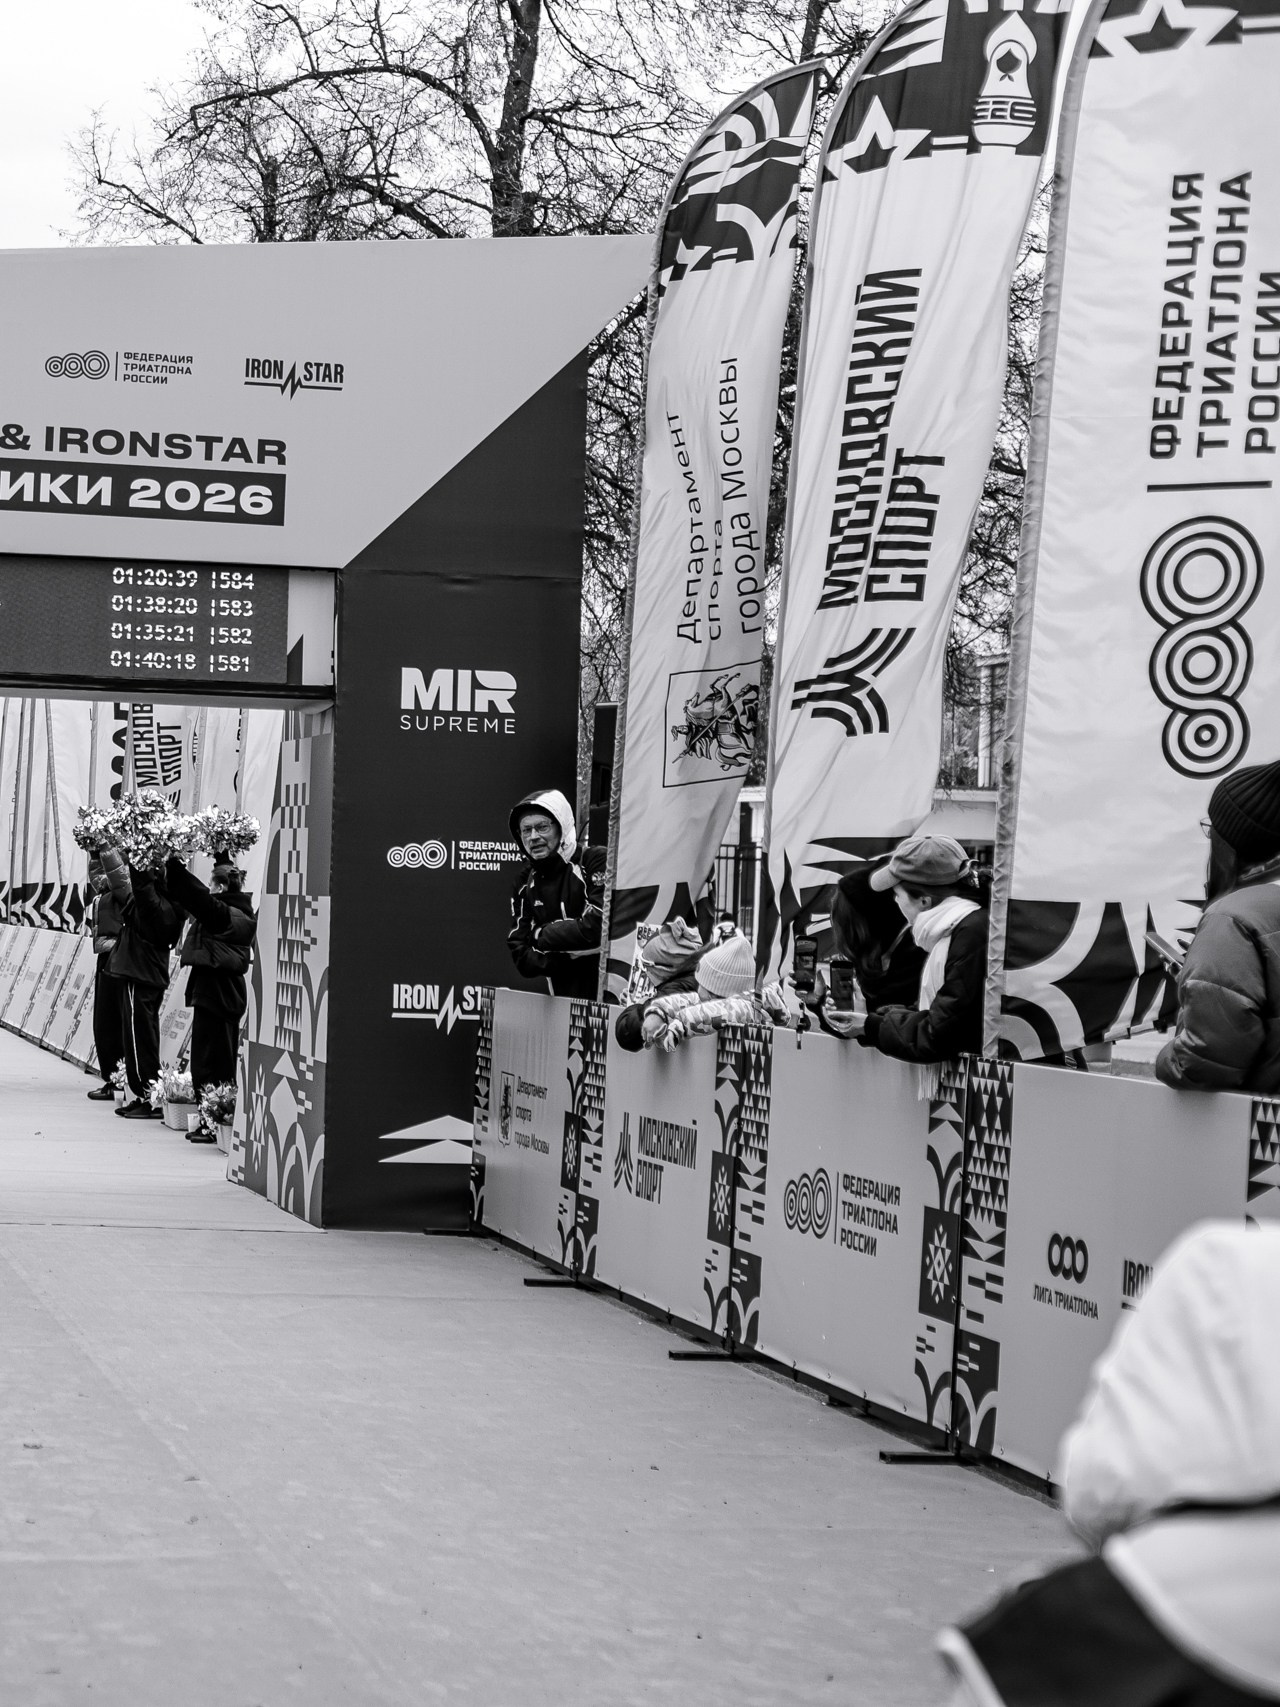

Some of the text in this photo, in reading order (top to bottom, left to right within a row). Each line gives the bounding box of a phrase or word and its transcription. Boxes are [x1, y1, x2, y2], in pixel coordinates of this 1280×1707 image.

[1149, 172, 1205, 459] ФЕДЕРАЦИЯ
[1196, 170, 1253, 458] ТРИАТЛОНА
[123, 352, 193, 364] ФЕДЕРАЦИЯ
[123, 363, 192, 375] ТРИАТЛОНА
[245, 358, 344, 383] IRON STAR
[1245, 272, 1280, 454] РОССИИ
[123, 374, 168, 384] РОССИИ
[45, 426, 287, 466] IRONSTAR
[815, 268, 923, 612] МОСКОВСКИЙ
[129, 478, 273, 515] 2026
[718, 358, 762, 634] города Москвы
[666, 411, 709, 643] Департамент
[863, 448, 945, 602] СПОРТ
[707, 520, 724, 641] спорта
[401, 667, 517, 713] MIR
[400, 714, 516, 734] SUPREME
[157, 722, 182, 787] СПОРТ
[459, 840, 521, 852] ФЕДЕРАЦИ
[459, 861, 501, 871] РОССИИ
[393, 983, 482, 1011] IRON ST
[516, 1076, 548, 1101] Департамент
[515, 1105, 532, 1124] спорта
[530, 1136, 550, 1155] Москвы
[638, 1115, 697, 1170] МОСКОВСКИЙ
[635, 1158, 664, 1204] СПОРТ
[841, 1173, 901, 1207] ФЕДЕРАЦИЯ
[841, 1200, 899, 1235] ТРИАТЛОНА
[839, 1227, 877, 1257] РОССИИ
[1033, 1284, 1099, 1320] ЛИГА ТРИАТЛОНА
